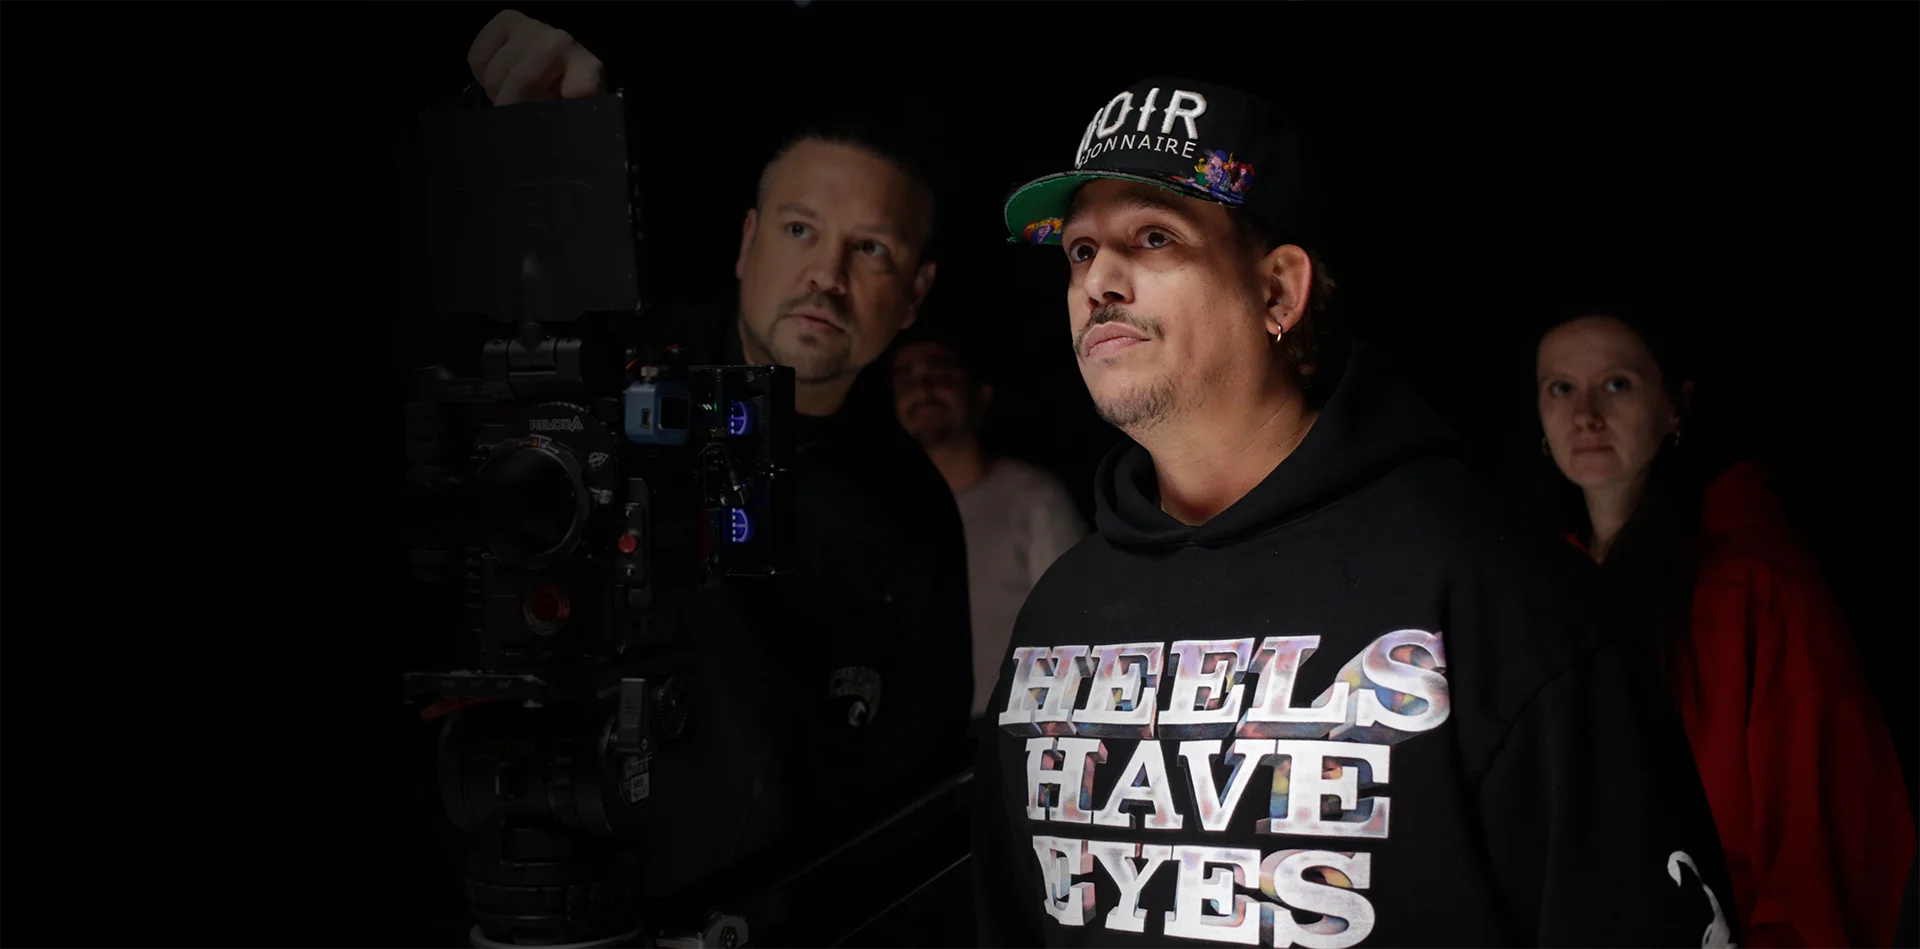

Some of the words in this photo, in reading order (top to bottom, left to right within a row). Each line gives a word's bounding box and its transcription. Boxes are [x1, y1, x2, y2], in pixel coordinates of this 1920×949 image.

[998, 628, 1451, 740] HEELS
[1025, 738, 1391, 839] HAVE
[1032, 834, 1376, 949] EYES
